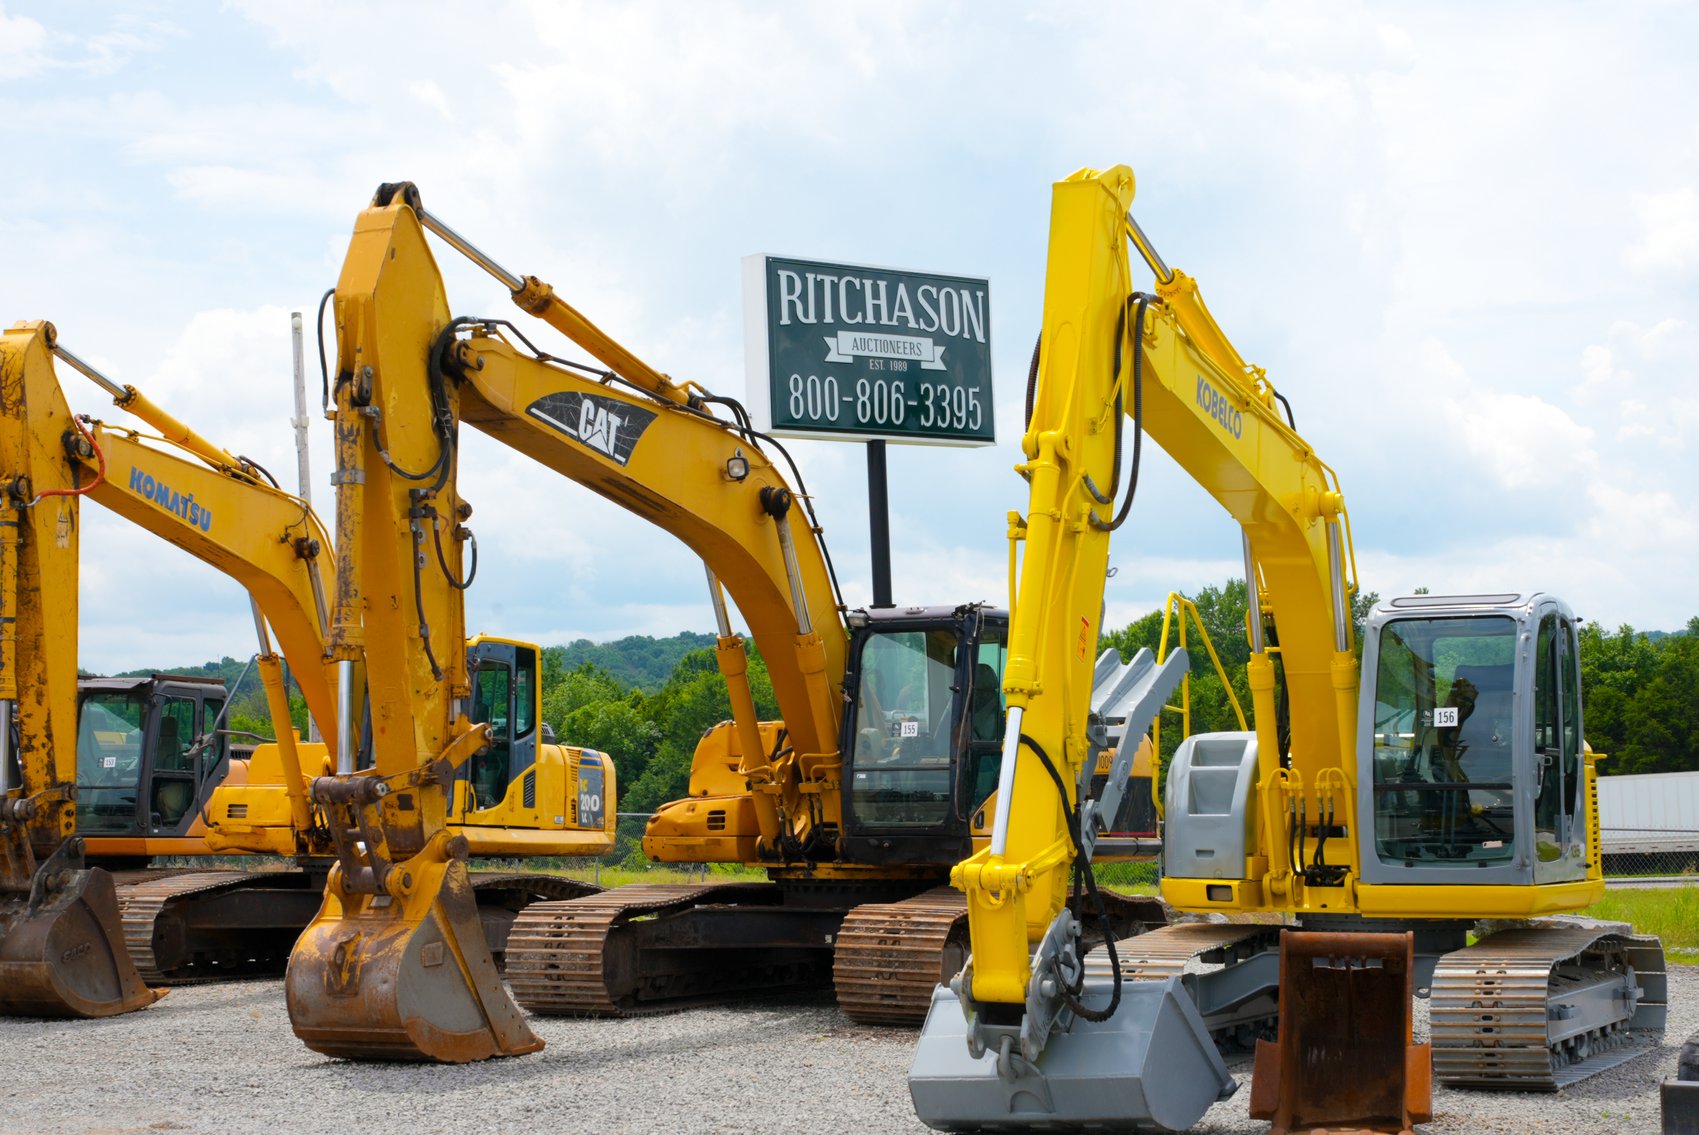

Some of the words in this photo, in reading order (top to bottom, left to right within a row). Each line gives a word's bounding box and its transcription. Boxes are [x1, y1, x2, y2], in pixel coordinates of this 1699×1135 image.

[777, 269, 986, 343] RITCHASON
[851, 337, 923, 356] AUCTIONEERS
[869, 359, 886, 371] EST.
[889, 360, 908, 372] 1989
[789, 374, 982, 430] 800-806-3395
[1196, 374, 1242, 440] KOBELCO
[578, 399, 621, 456] CAT
[129, 466, 212, 532] KOMATSU
[903, 724, 916, 735] 155
[1438, 711, 1455, 724] 156
[580, 794, 600, 811] 200
